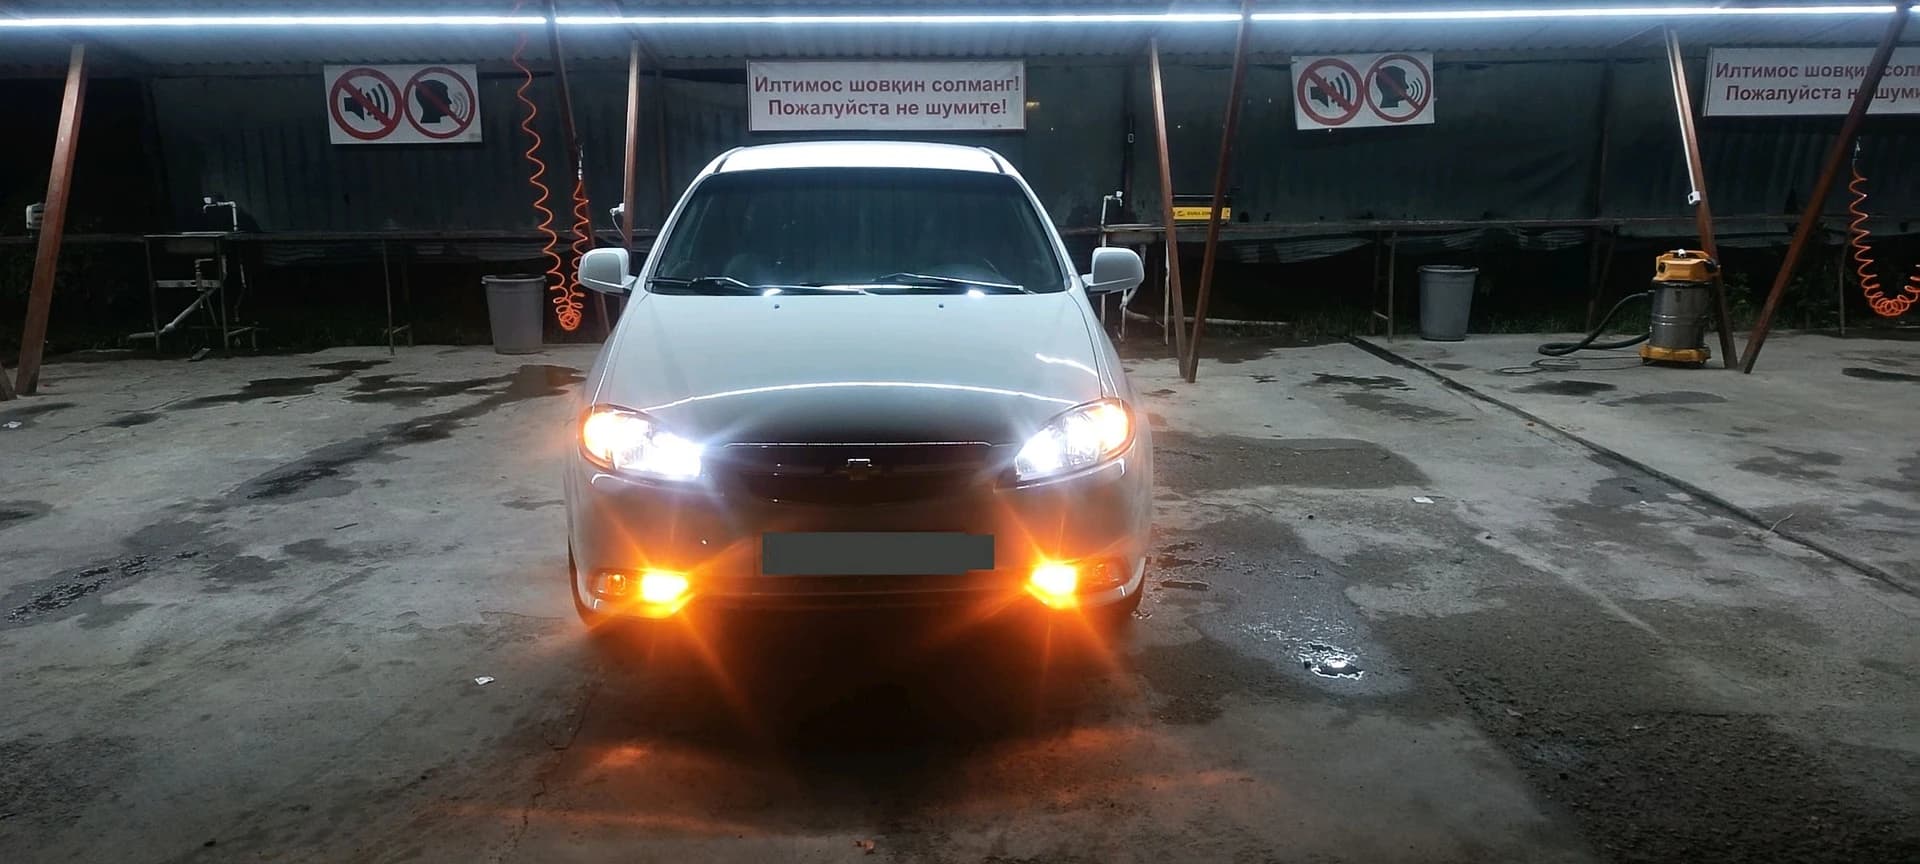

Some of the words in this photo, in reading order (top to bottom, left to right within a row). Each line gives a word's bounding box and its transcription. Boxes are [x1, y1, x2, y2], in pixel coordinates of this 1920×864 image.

[1715, 63, 1799, 78] Илтимос
[1882, 65, 1920, 77] сол
[755, 76, 842, 93] Илтимос
[850, 79, 925, 95] шовқин
[932, 75, 1020, 92] солманг!
[1726, 85, 1841, 104] Пожалуйста
[769, 99, 890, 119] Пожалуйста
[896, 101, 920, 115] не
[926, 98, 1007, 118] шумите!
